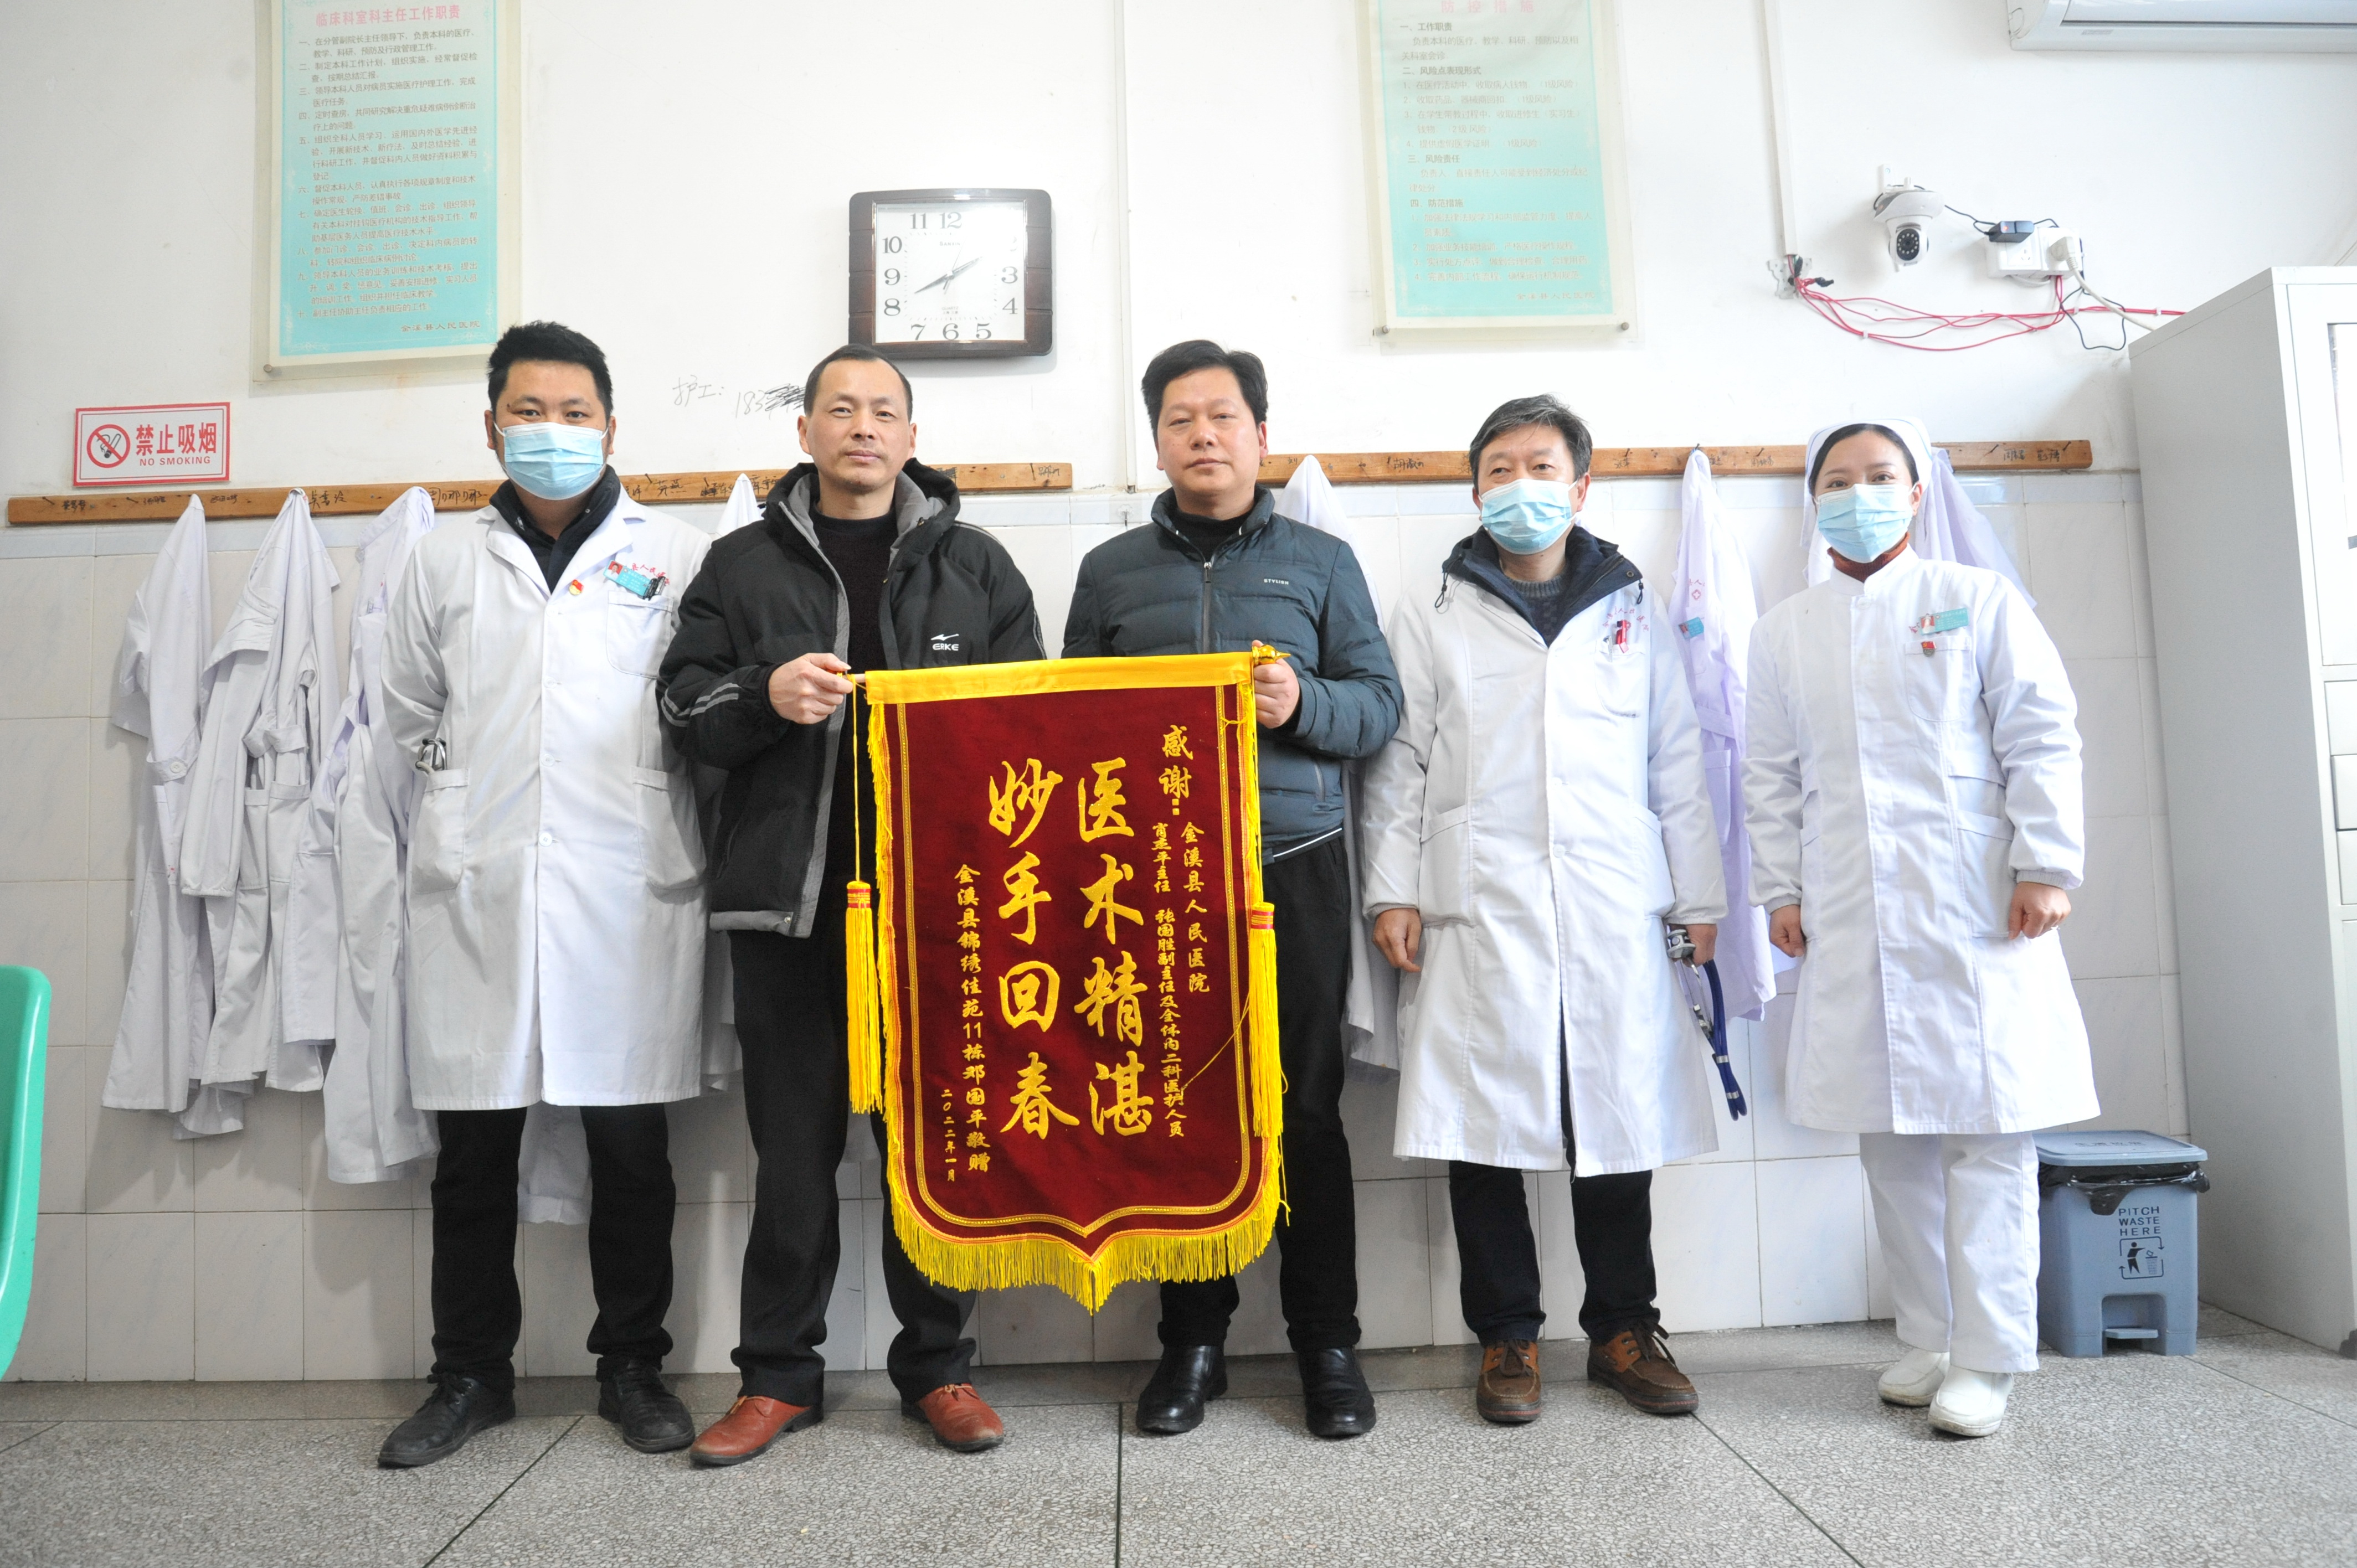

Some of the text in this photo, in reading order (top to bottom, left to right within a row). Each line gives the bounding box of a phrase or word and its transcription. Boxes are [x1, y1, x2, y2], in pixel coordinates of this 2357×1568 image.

[316, 5, 460, 27] 临床科室科主任工作职责
[1400, 22, 1452, 31] 一、工作职责
[1403, 66, 1481, 75] 二、风险点表现形式
[1408, 154, 1460, 163] 三、风险责任
[1410, 199, 1463, 208] 四、防范措施
[910, 213, 928, 229] 11
[939, 212, 962, 229] 12
[882, 236, 902, 254] 10
[884, 268, 900, 285] 9
[1001, 266, 1018, 283] 3
[884, 298, 900, 316] 8
[1002, 297, 1018, 314] 4
[401, 321, 480, 332] 金溪县人民医院
[911, 324, 926, 341] 7
[943, 323, 959, 341] 6
[976, 323, 991, 340] 5
[136, 422, 217, 456] 禁止吸烟
[159, 456, 210, 465] SMOKING
[932, 643, 959, 651] ERKE
[1159, 725, 1193, 816] 感谢：
[1181, 822, 1210, 993] 金溪县人民医院
[989, 758, 1080, 1139] 妙手回春
[1074, 757, 1154, 1136] 医术精湛
[954, 864, 991, 1172] 金溪县锦绣佳苑11栋邓国平敬赠
[2119, 1206, 2159, 1216] PITCH
[2119, 1216, 2160, 1226] WASTE
[2120, 1226, 2160, 1236] HERE
